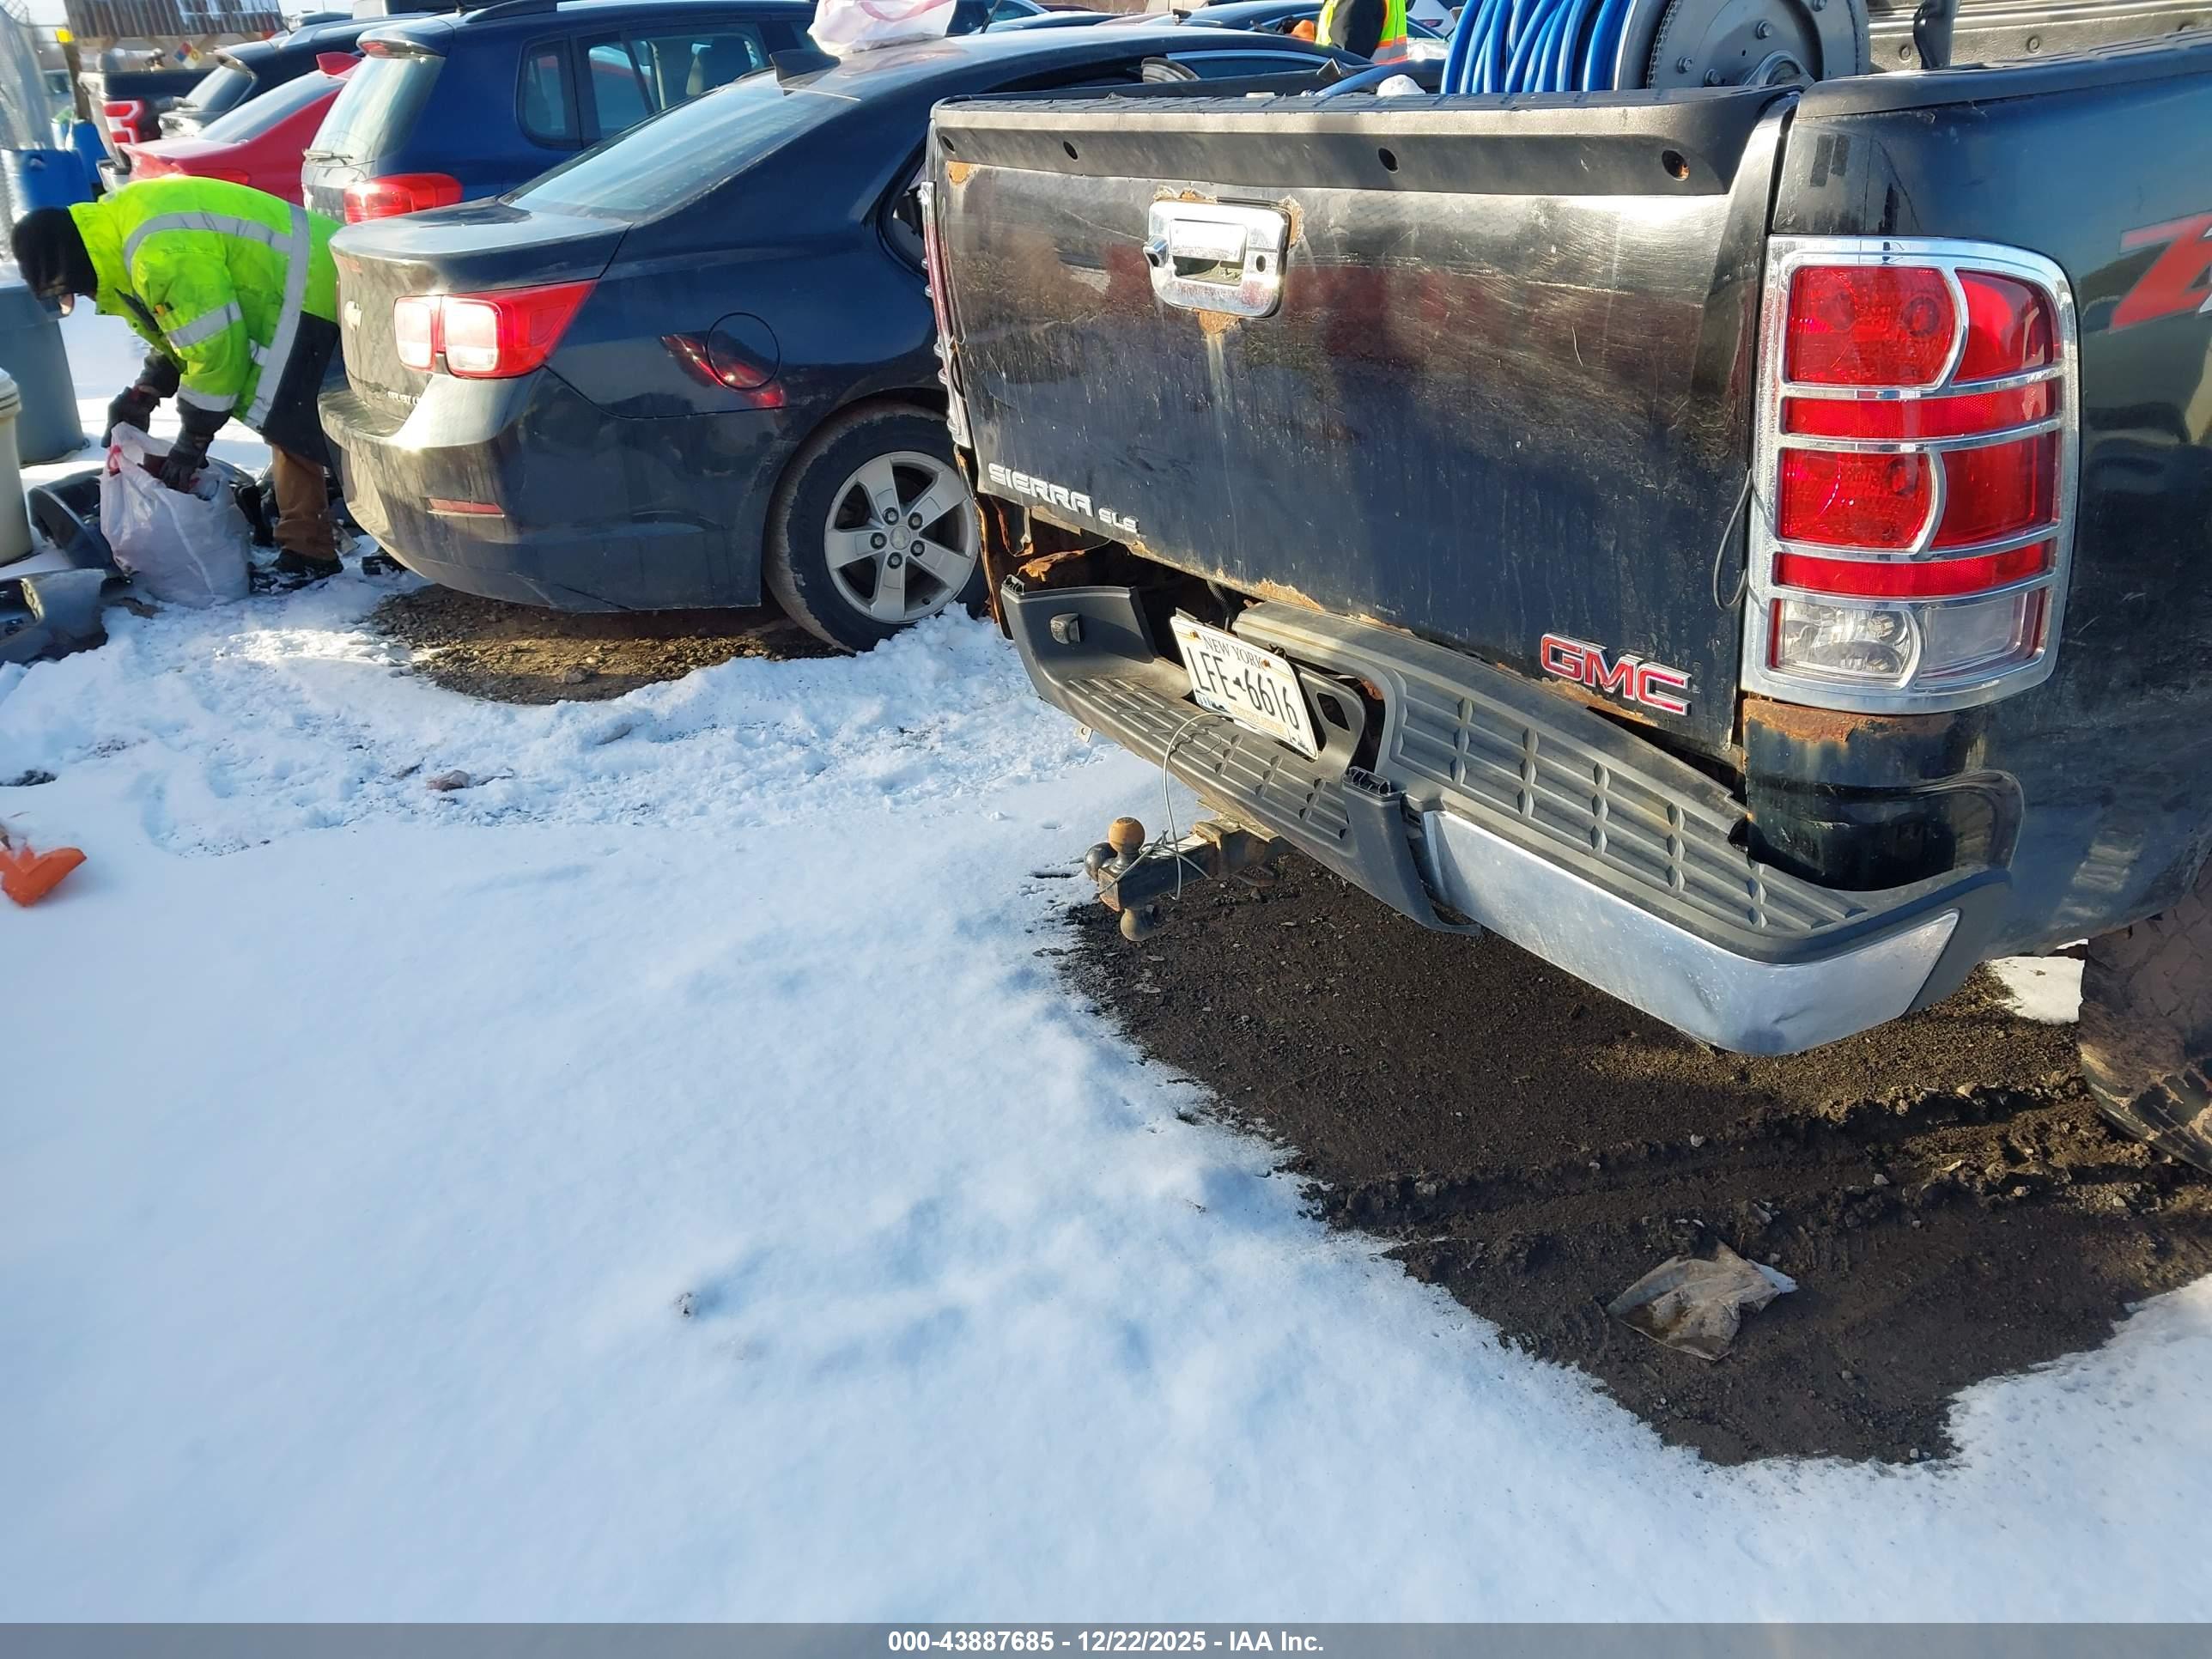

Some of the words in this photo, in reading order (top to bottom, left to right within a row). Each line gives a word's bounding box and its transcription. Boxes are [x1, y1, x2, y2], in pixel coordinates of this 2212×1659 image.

[988, 462, 1095, 517] SIERRA
[1098, 507, 1139, 533] SLE
[1202, 635, 1231, 656] NEW
[1231, 646, 1265, 670] YORK
[1540, 632, 1692, 716] GMC
